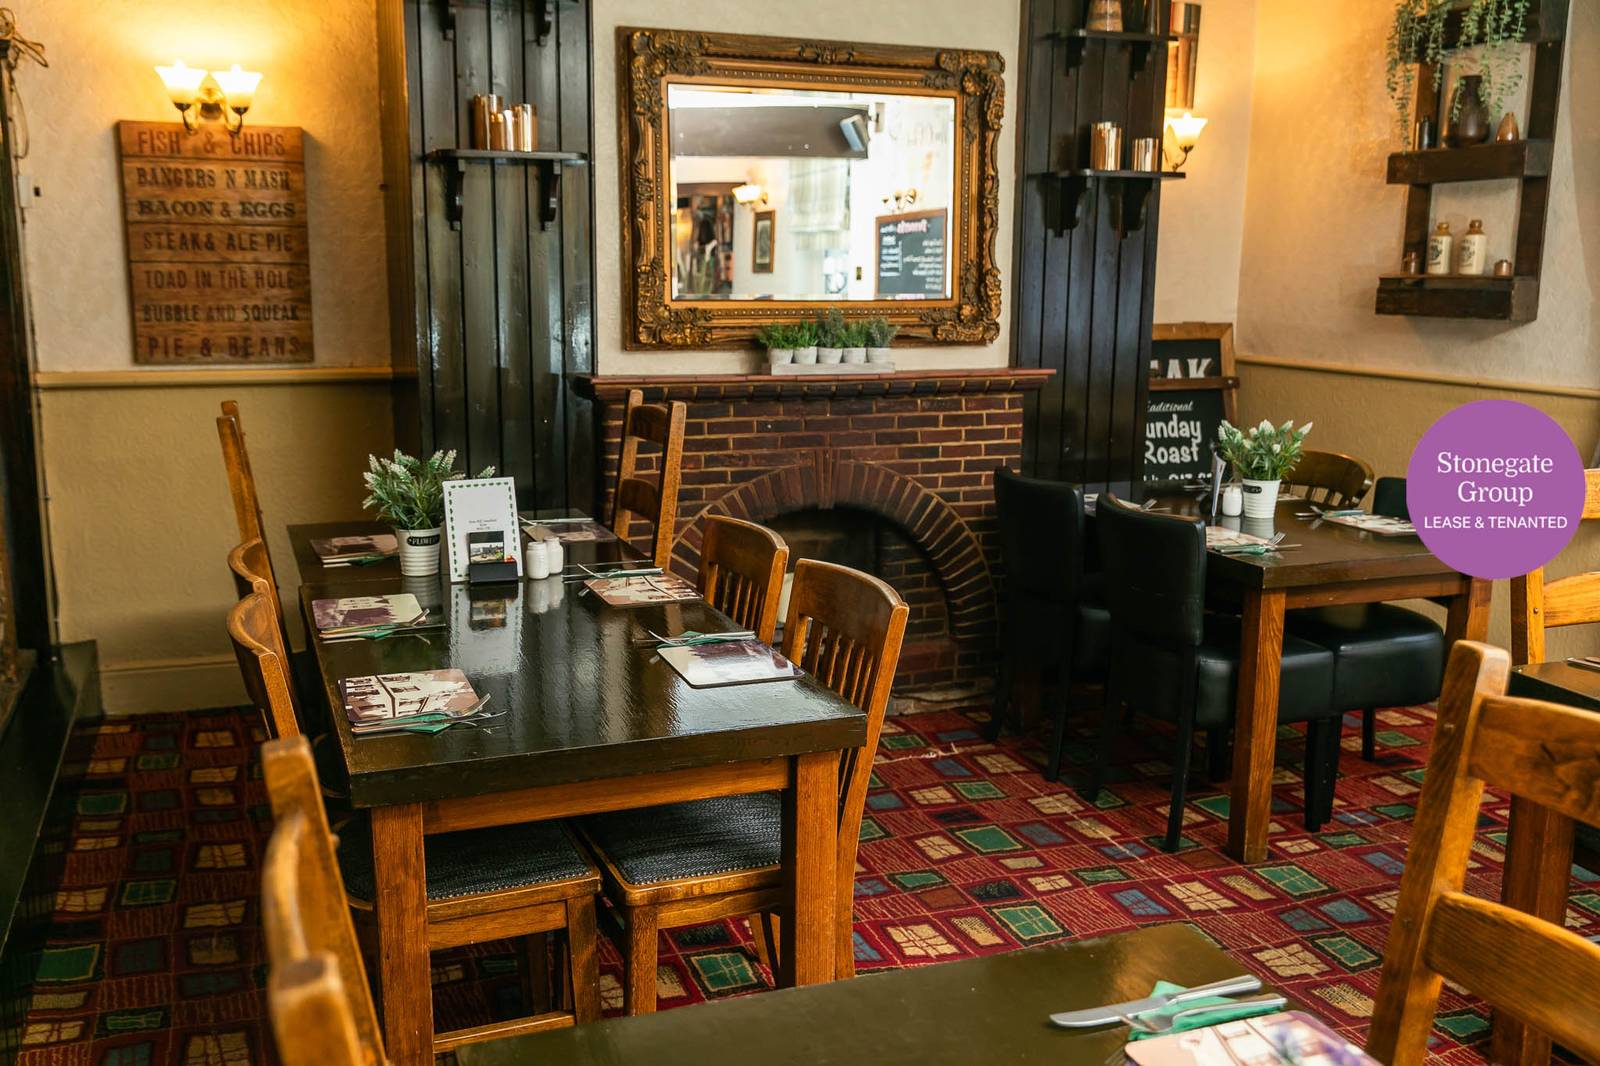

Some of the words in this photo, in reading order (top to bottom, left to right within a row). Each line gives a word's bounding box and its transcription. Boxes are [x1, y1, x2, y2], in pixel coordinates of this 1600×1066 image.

[137, 130, 181, 154] FISH
[203, 131, 216, 154] &
[230, 132, 286, 156] CHIPS
[136, 167, 216, 188] BANGERS
[244, 169, 291, 191] MASH
[138, 200, 215, 216] BACON
[220, 202, 231, 218] &
[239, 201, 296, 218] EGGS
[226, 233, 258, 251] ALE
[266, 233, 293, 252] PIE
[143, 270, 187, 289] TOAD
[195, 271, 212, 289] IN
[219, 270, 248, 289] THE
[255, 271, 295, 289] HOLE
[142, 304, 200, 322] BUBBLE
[206, 304, 236, 321] AND
[242, 304, 300, 321] SQUEAK
[149, 336, 184, 357] PIE
[200, 337, 212, 357] &
[228, 336, 301, 358] BEANS
[1147, 400, 1194, 412] aditional
[1145, 413, 1202, 443] unday
